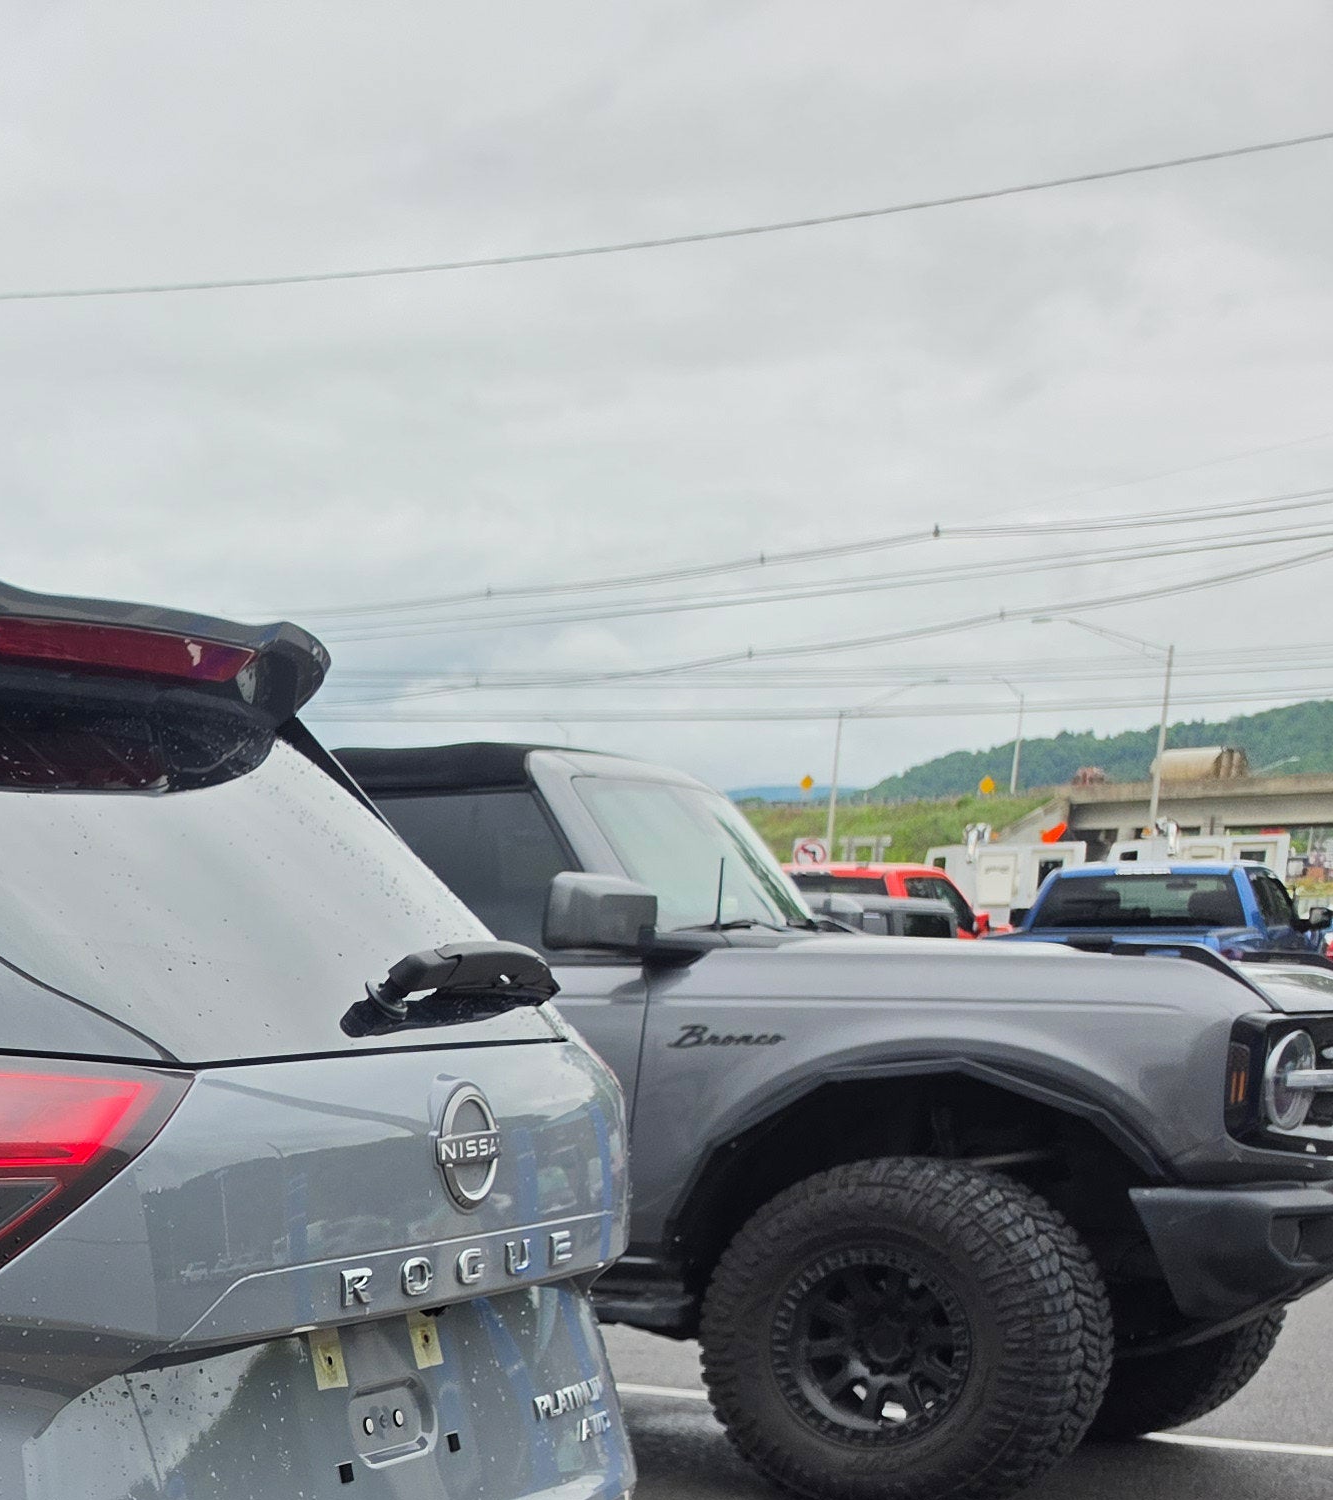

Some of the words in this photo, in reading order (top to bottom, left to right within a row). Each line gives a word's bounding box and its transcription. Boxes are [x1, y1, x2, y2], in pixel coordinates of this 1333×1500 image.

[665, 1023, 787, 1049] Bronco
[441, 1138, 500, 1160] NISSA
[340, 1230, 575, 1308] ROGUE
